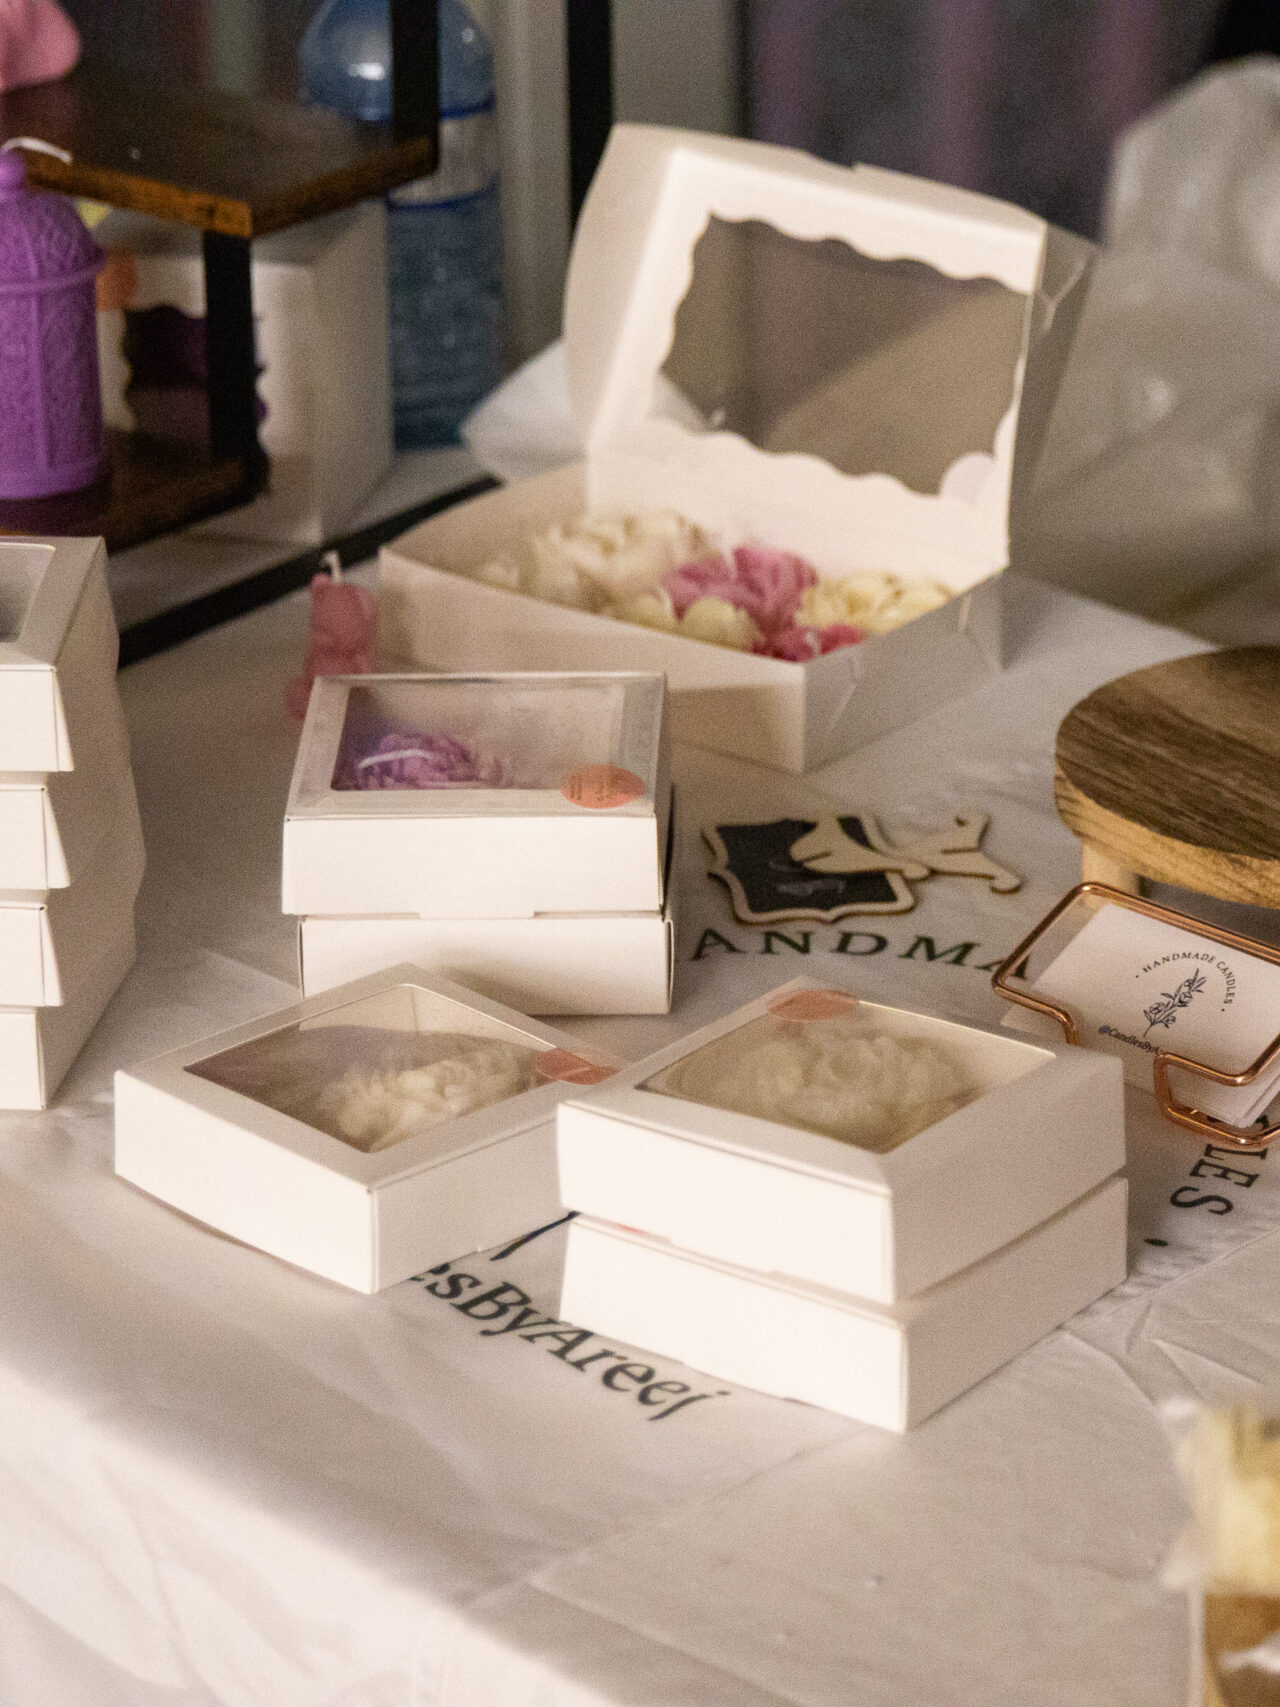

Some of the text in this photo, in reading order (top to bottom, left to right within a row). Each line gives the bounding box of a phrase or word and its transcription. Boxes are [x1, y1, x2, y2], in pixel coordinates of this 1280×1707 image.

[1142, 951, 1237, 1005] HANDMADE CANDLES
[1169, 1113, 1271, 1216] LES
